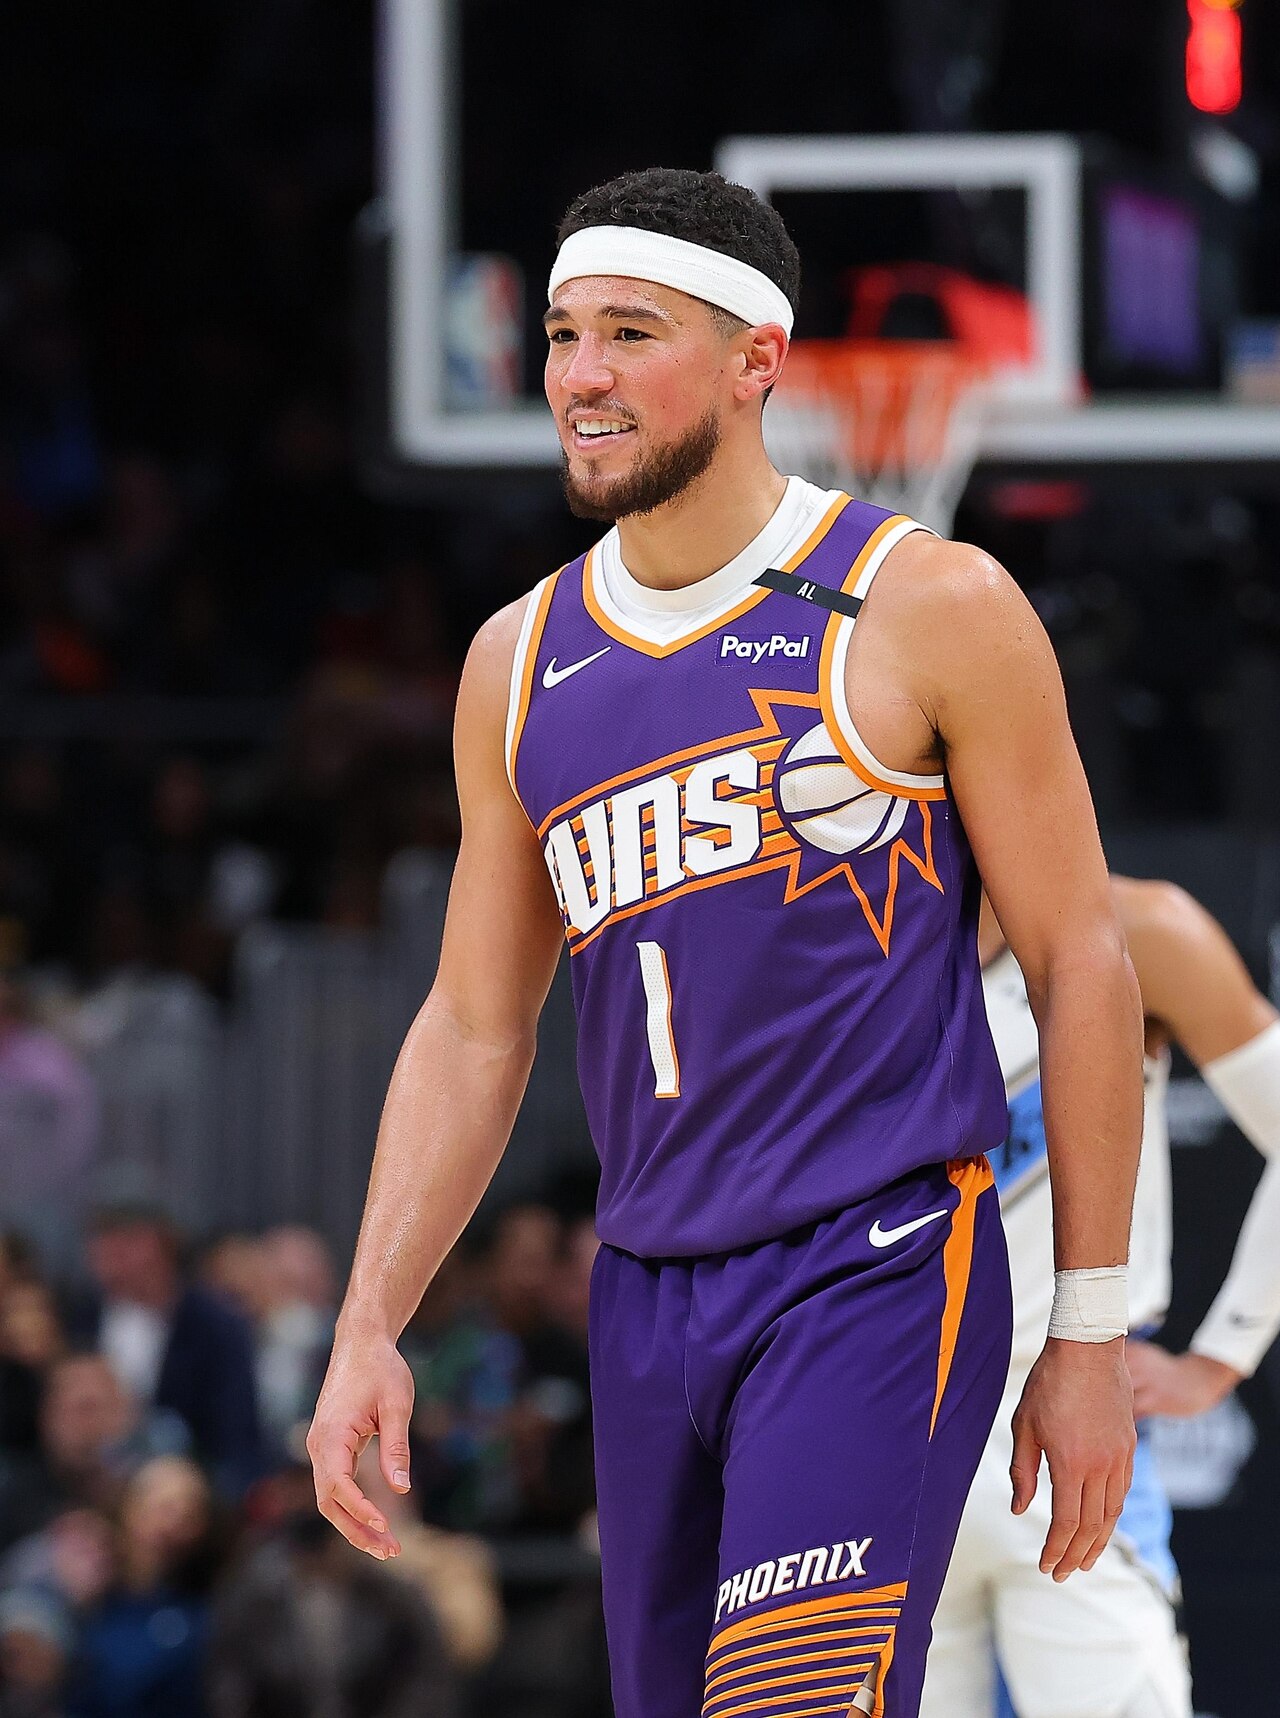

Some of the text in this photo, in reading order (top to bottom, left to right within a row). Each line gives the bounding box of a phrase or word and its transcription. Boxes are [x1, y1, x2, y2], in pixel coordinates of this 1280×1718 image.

[796, 581, 818, 601] AL
[719, 634, 810, 664] PayPal
[635, 940, 681, 1099] 1
[714, 1536, 873, 1625] PHOENIX
